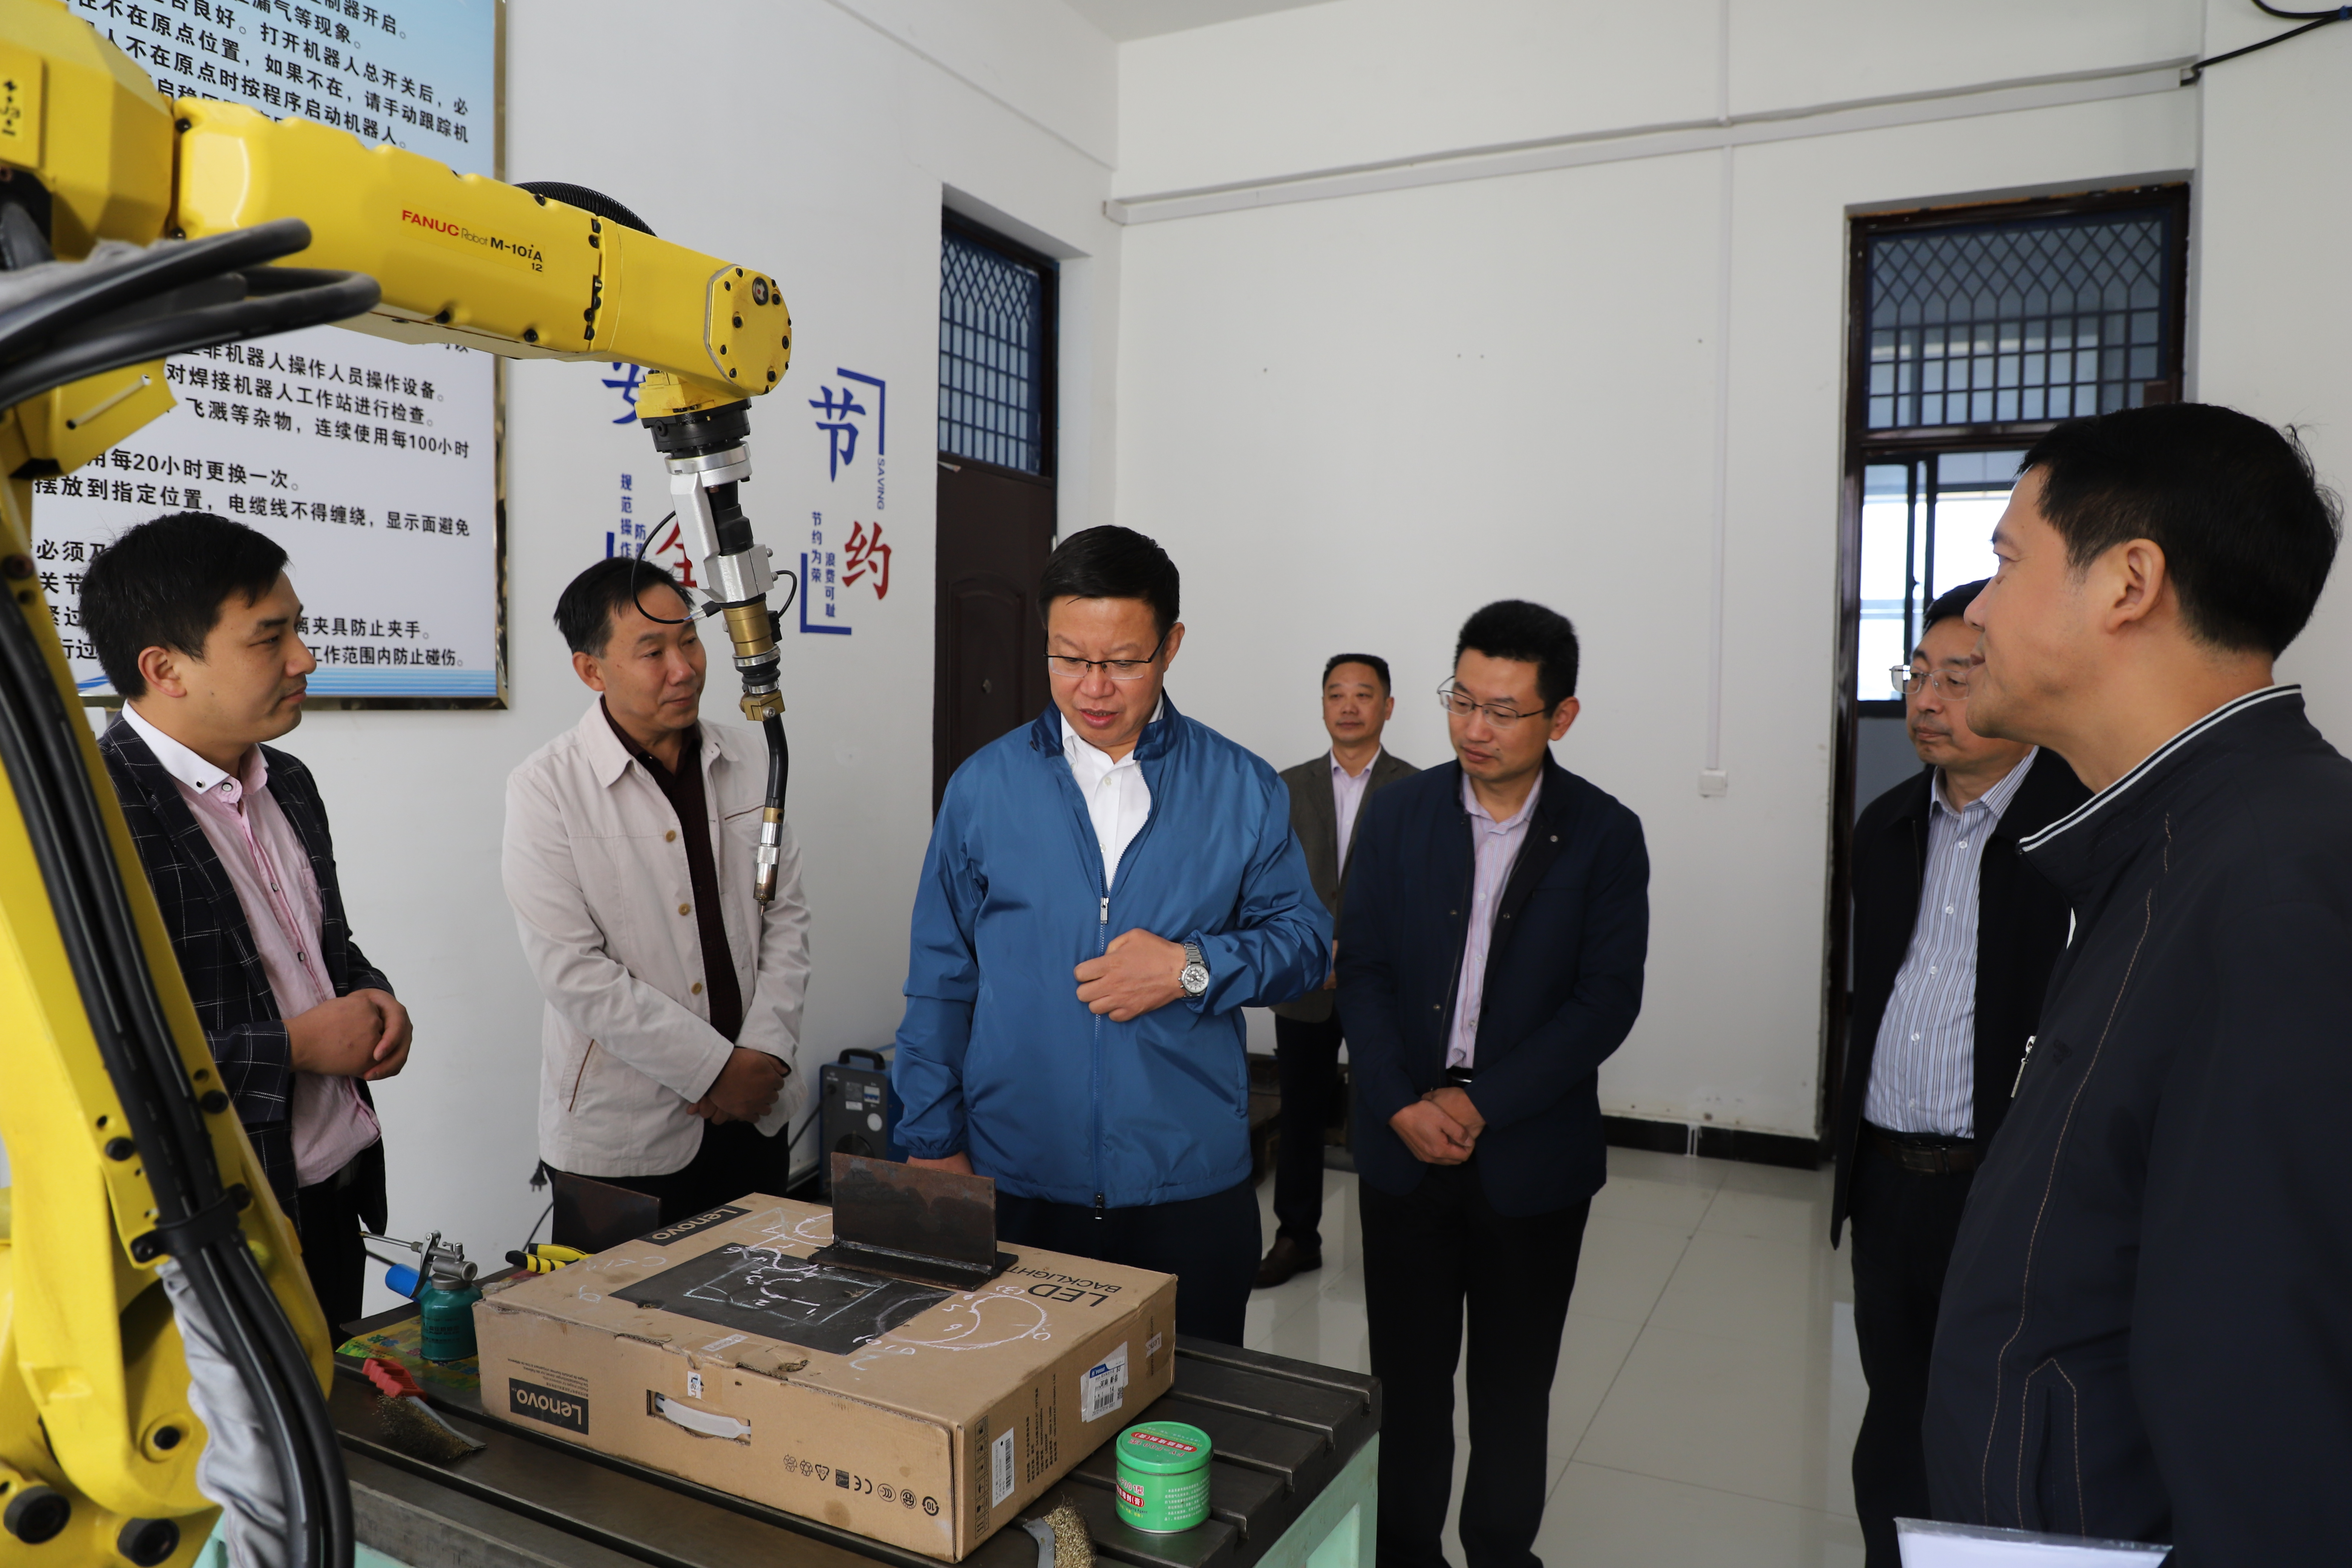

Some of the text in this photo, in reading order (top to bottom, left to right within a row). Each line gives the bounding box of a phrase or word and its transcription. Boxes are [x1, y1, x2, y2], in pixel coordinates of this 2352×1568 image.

[235, 0, 360, 49] 漏气等现象。
[310, 0, 406, 39] 制器开启。
[402, 210, 543, 262] FANUC Robot M-10iA
[531, 263, 543, 273] 12
[166, 363, 435, 427] 对焊接机器人工作站进行检查。
[808, 384, 867, 483] 节
[877, 457, 885, 510] SAVING
[811, 511, 822, 583] 节约为荣
[842, 520, 892, 600] 约
[825, 552, 835, 617] 浪费可耻
[652, 1208, 738, 1240] Lenovo
[1004, 1266, 1122, 1293] BACKLIGHT
[1028, 1284, 1109, 1307] LED
[516, 1389, 581, 1425] Lenovo
